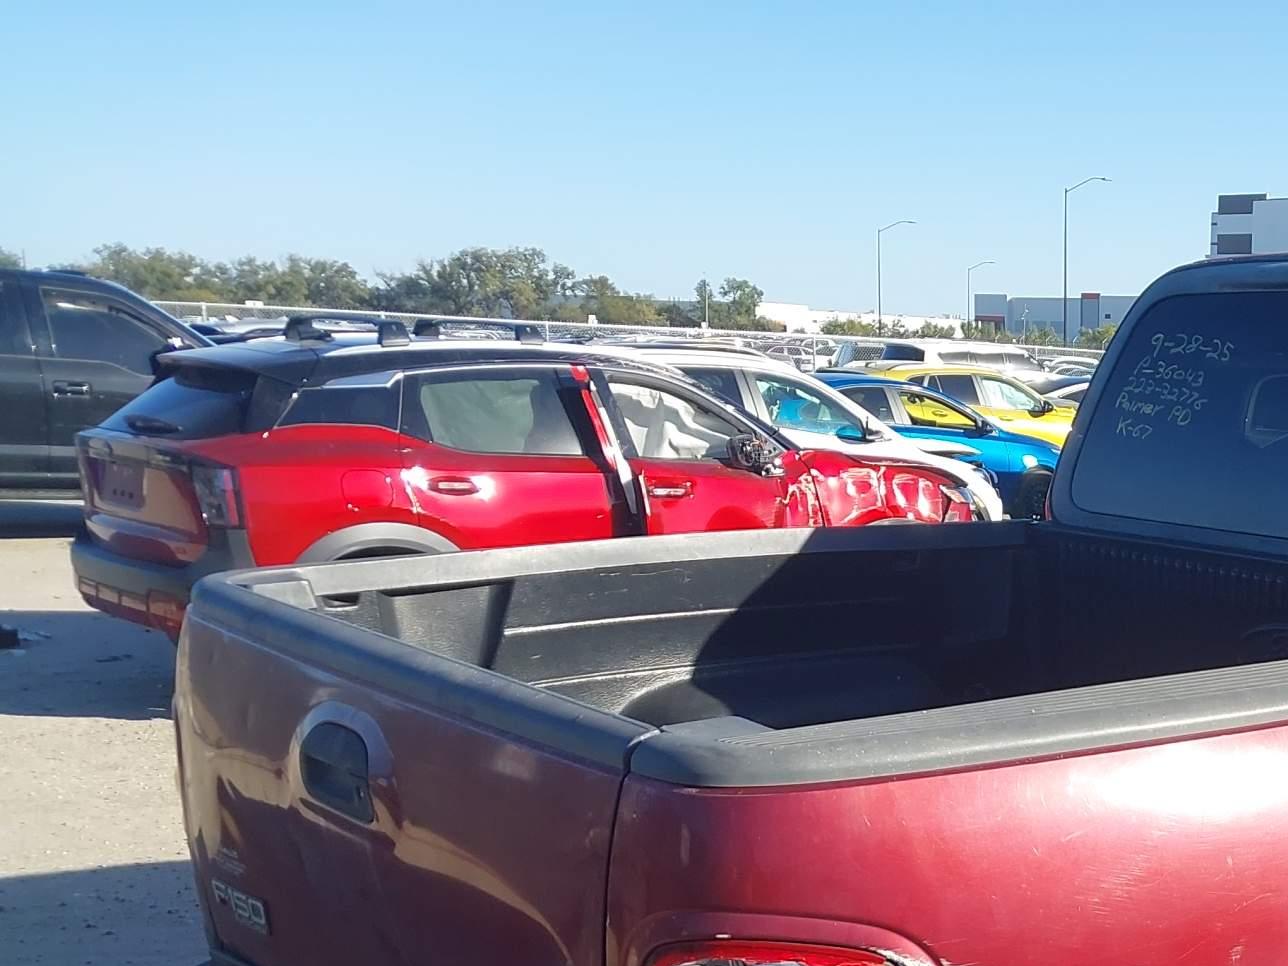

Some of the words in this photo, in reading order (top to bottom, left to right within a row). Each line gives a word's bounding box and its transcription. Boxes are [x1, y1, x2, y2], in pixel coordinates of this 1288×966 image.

[1151, 333, 1235, 361] 9-28-25
[1133, 355, 1205, 387] P-36043
[1114, 391, 1165, 417] Palmer
[1168, 405, 1192, 426] PD
[1123, 376, 1208, 410] 223-32776
